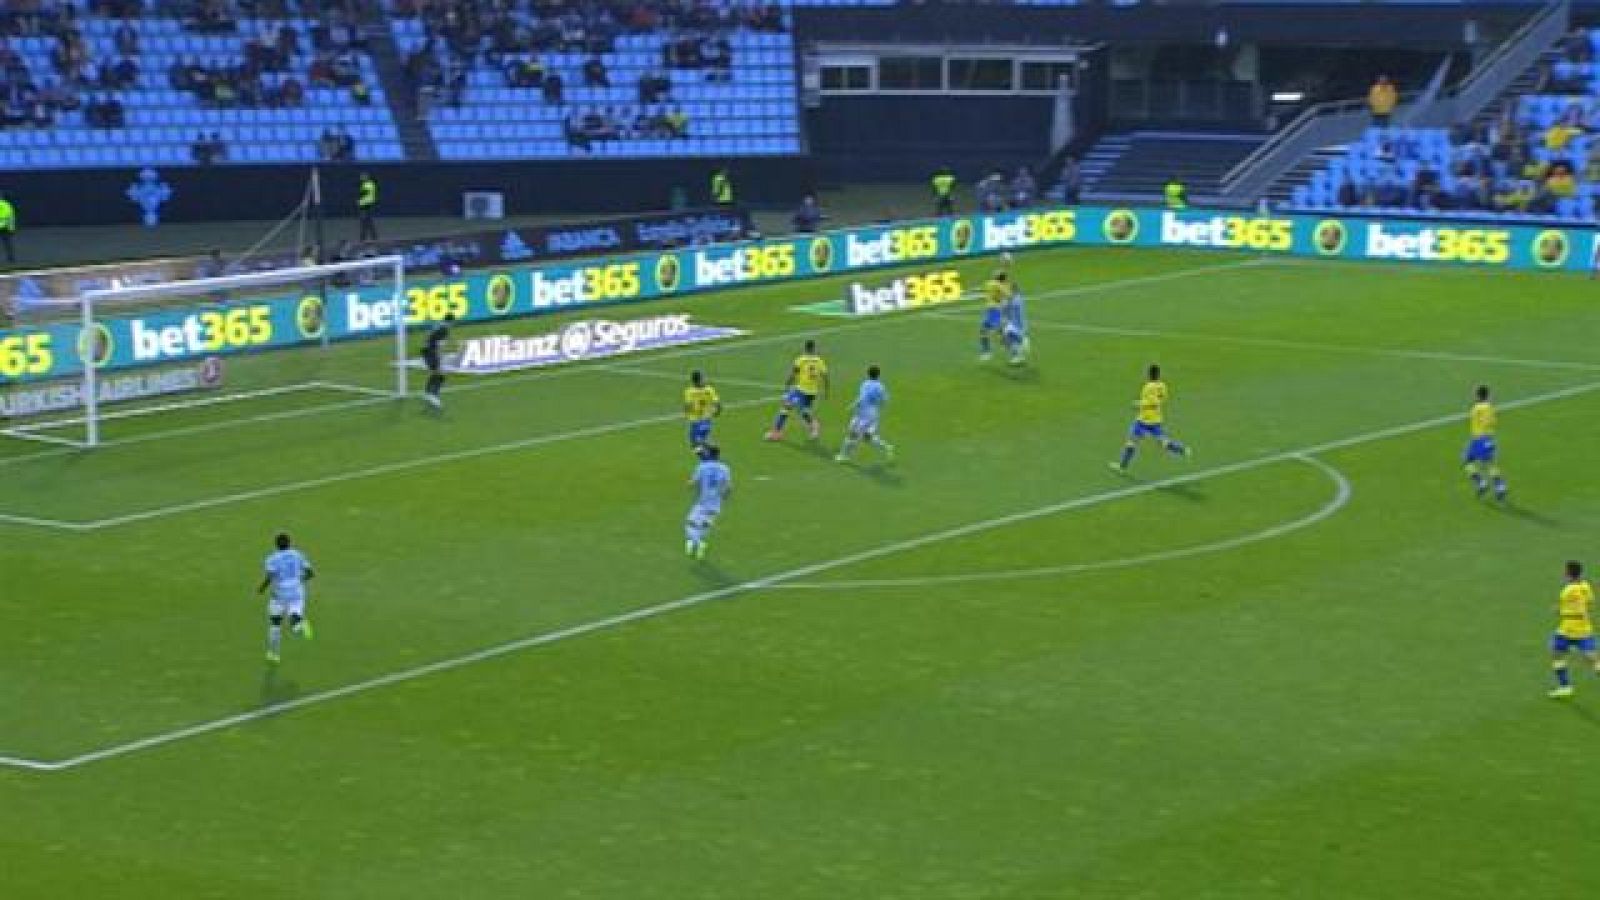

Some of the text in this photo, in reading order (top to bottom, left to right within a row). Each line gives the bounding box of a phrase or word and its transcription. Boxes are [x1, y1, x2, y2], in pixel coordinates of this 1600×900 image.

[847, 227, 938, 267] bet365
[984, 211, 1076, 248] bet365
[1161, 212, 1292, 251] bet365
[1366, 223, 1509, 263] bet365
[532, 263, 640, 306] bet365
[695, 244, 795, 286] bet365
[851, 270, 961, 315] bet365
[131, 305, 272, 360] bet365
[460, 313, 691, 368] Allianz Seguros
